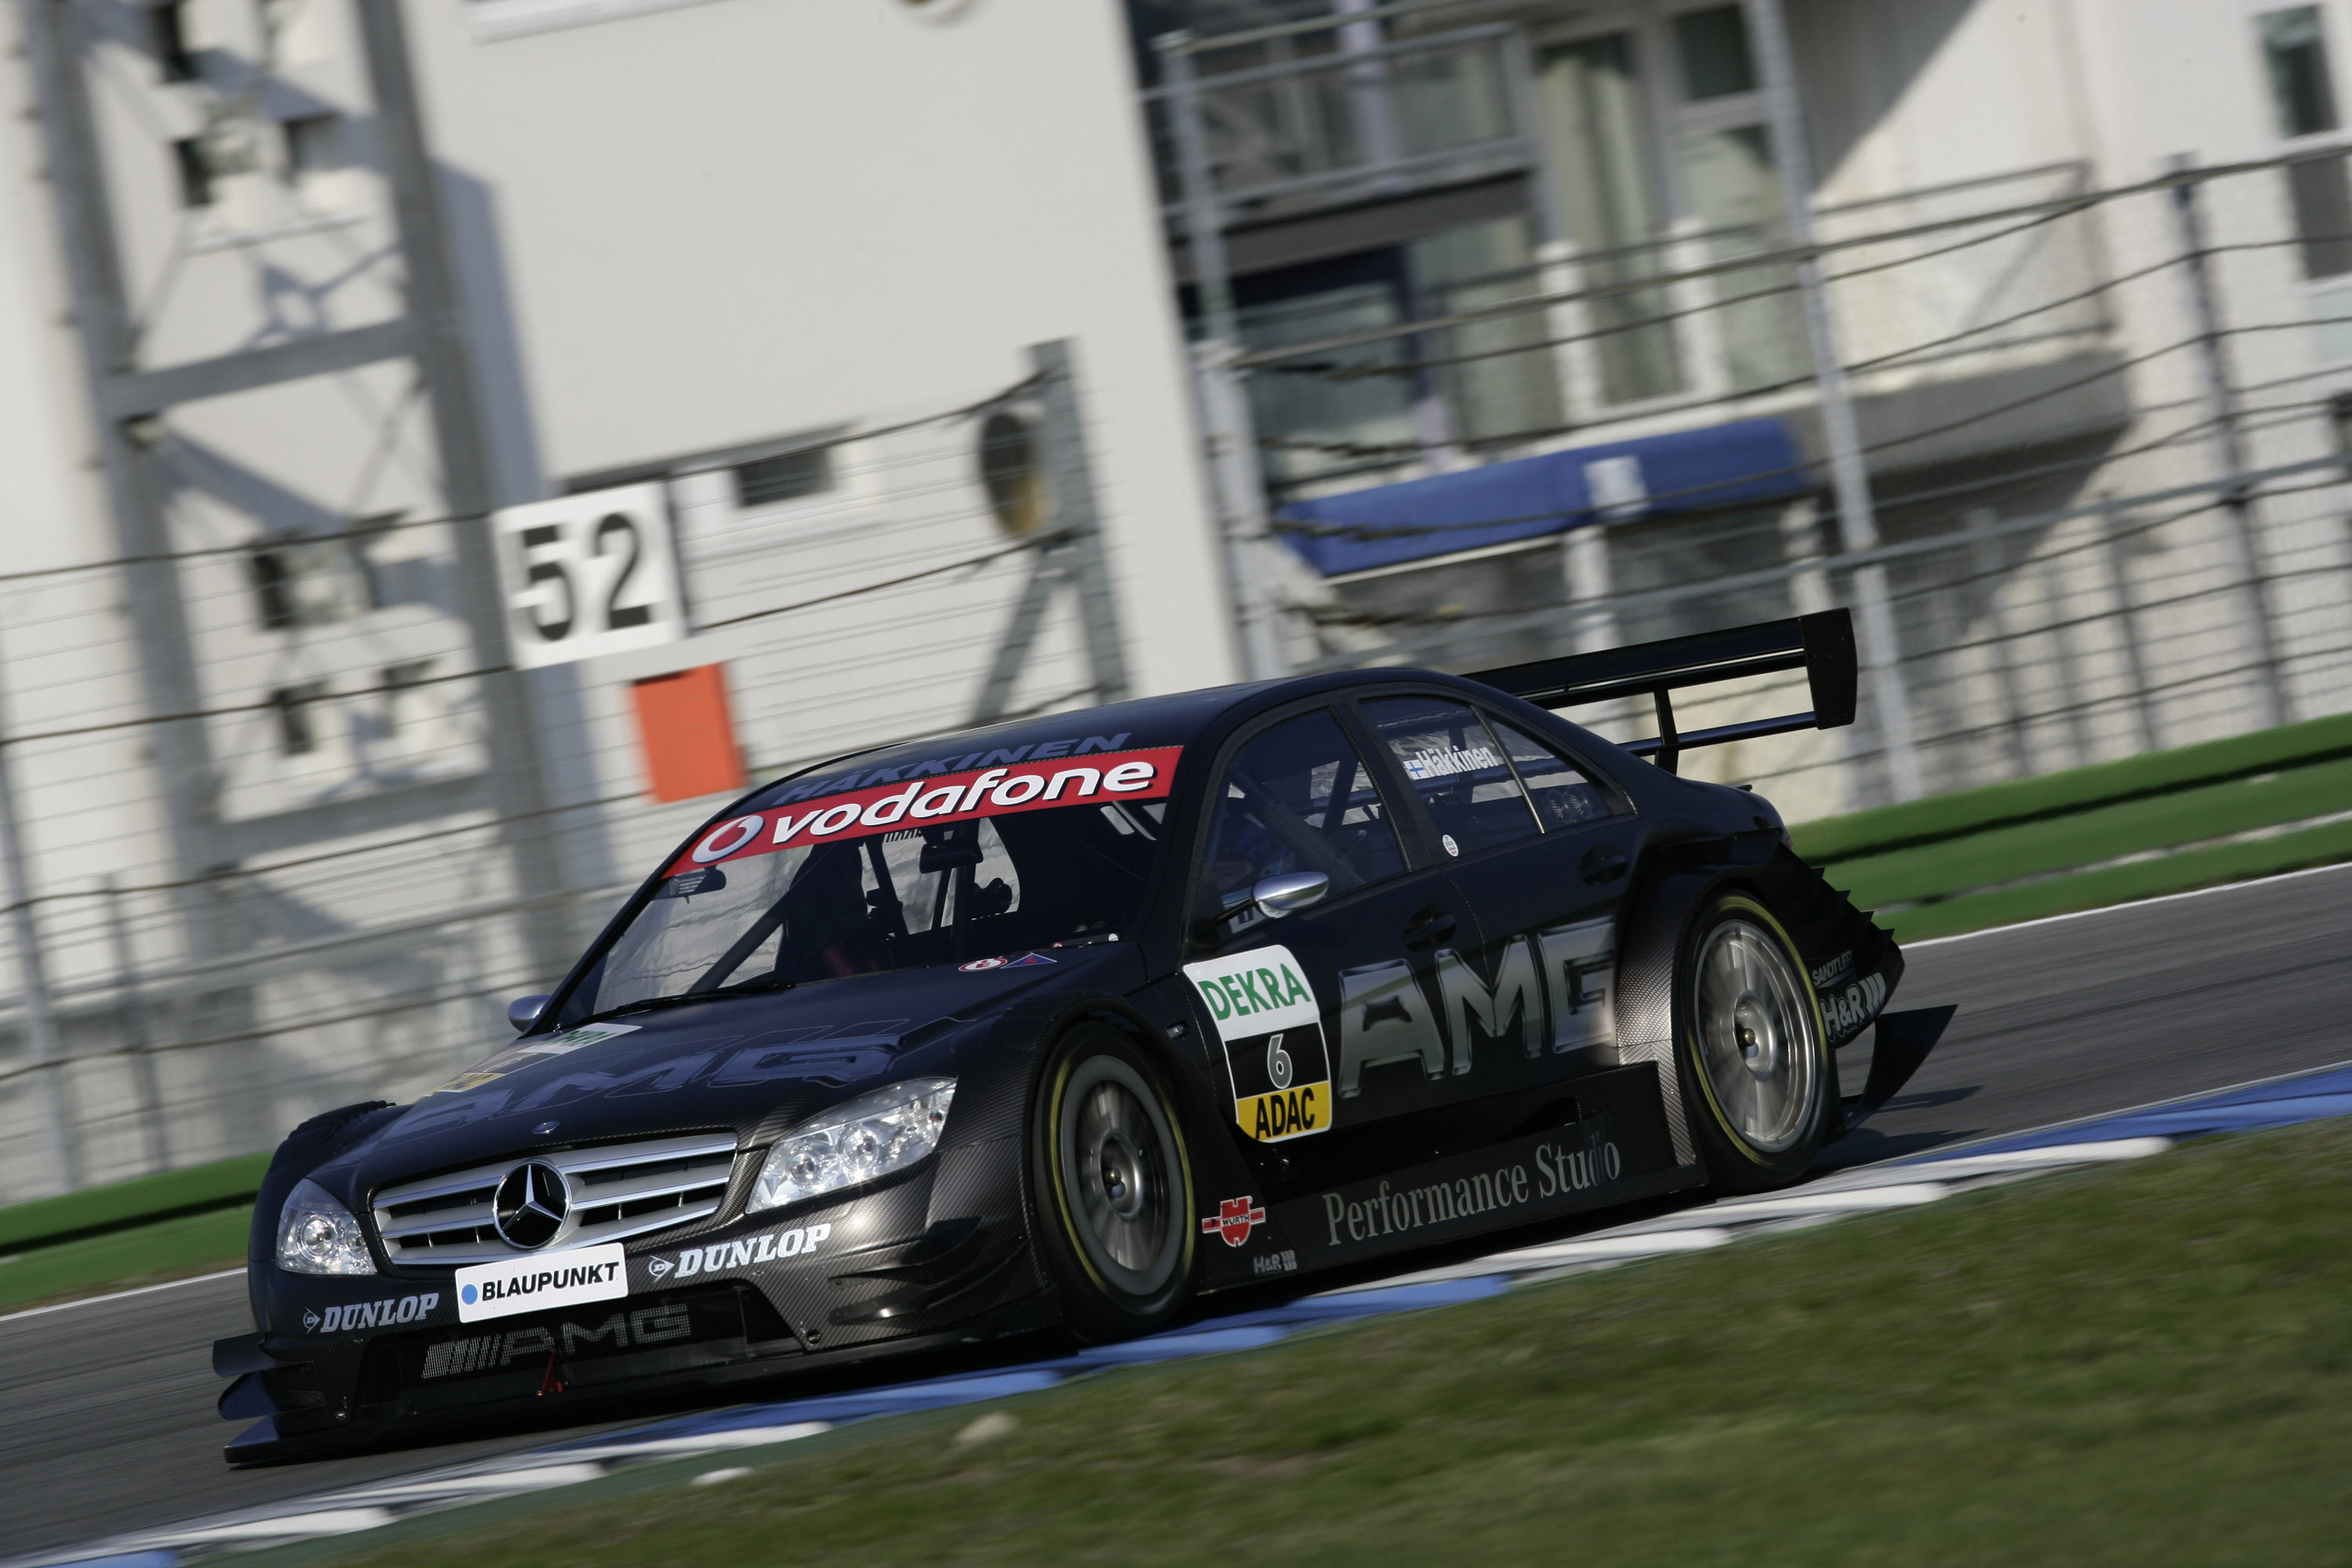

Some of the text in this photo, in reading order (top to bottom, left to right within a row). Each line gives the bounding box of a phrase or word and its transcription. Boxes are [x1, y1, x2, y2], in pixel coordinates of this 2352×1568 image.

[521, 513, 651, 641] 52
[1415, 745, 1498, 777] Häkkinen
[772, 760, 1156, 844] vodafone
[1197, 963, 1311, 1022] DEKRA
[1813, 949, 1853, 987] SANDTLER
[1337, 916, 1615, 1098] AMG
[1820, 985, 1865, 1036] H&R
[1267, 1033, 1293, 1089] 6
[1255, 1087, 1316, 1140] ADAC
[1323, 1140, 1621, 1246] Performance Studio
[674, 1223, 831, 1279] DUNLOP
[1254, 1254, 1282, 1274] H&R
[481, 1261, 619, 1301] BLAUPUNKT
[320, 1293, 439, 1333] DUNLOP
[499, 1302, 691, 1367] AMG
